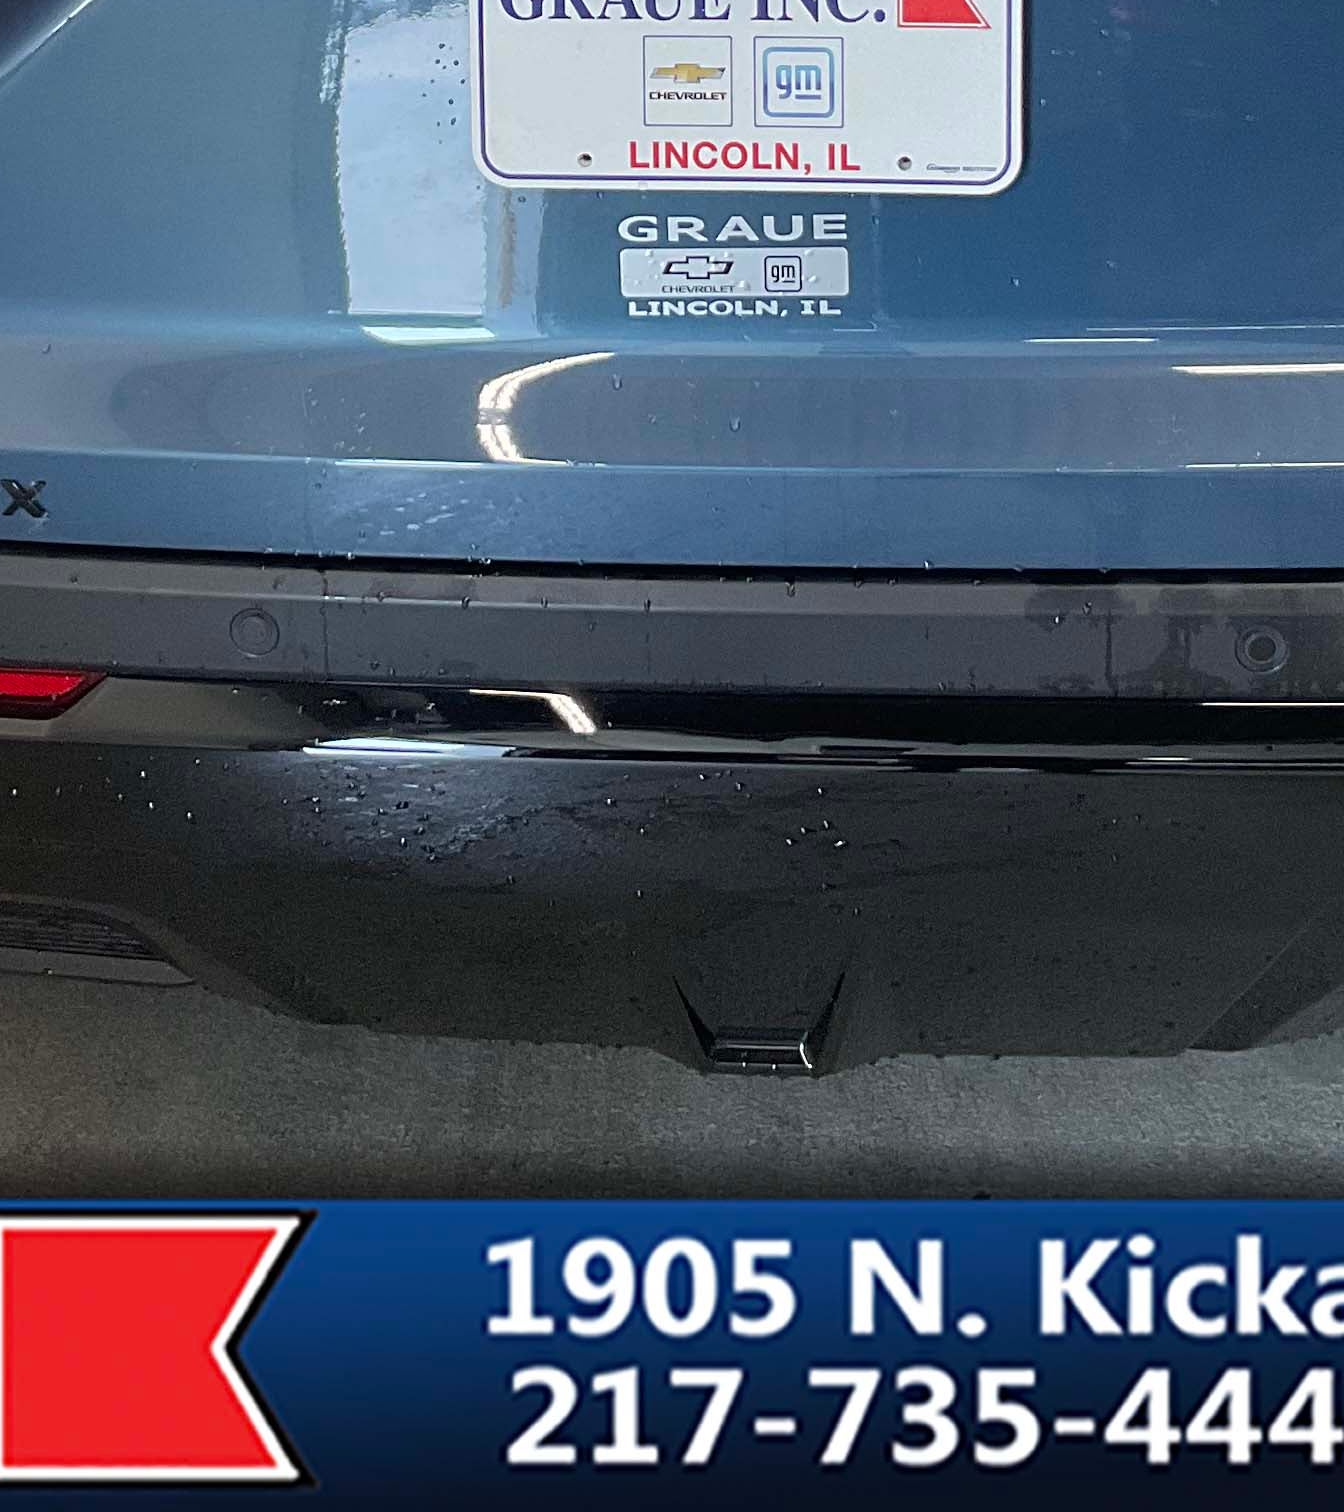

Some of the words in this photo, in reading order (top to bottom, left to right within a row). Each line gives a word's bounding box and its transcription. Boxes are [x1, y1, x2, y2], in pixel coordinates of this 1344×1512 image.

[775, 64, 822, 100] gm
[649, 90, 727, 101] CHEVROLET
[629, 141, 812, 175] LINCOLN,
[828, 143, 861, 172] IL
[618, 213, 848, 242] GRAUE
[770, 263, 797, 285] gm
[661, 284, 735, 294] CHEVROLET
[628, 299, 788, 318] LINCOLN,
[800, 299, 841, 316] IL
